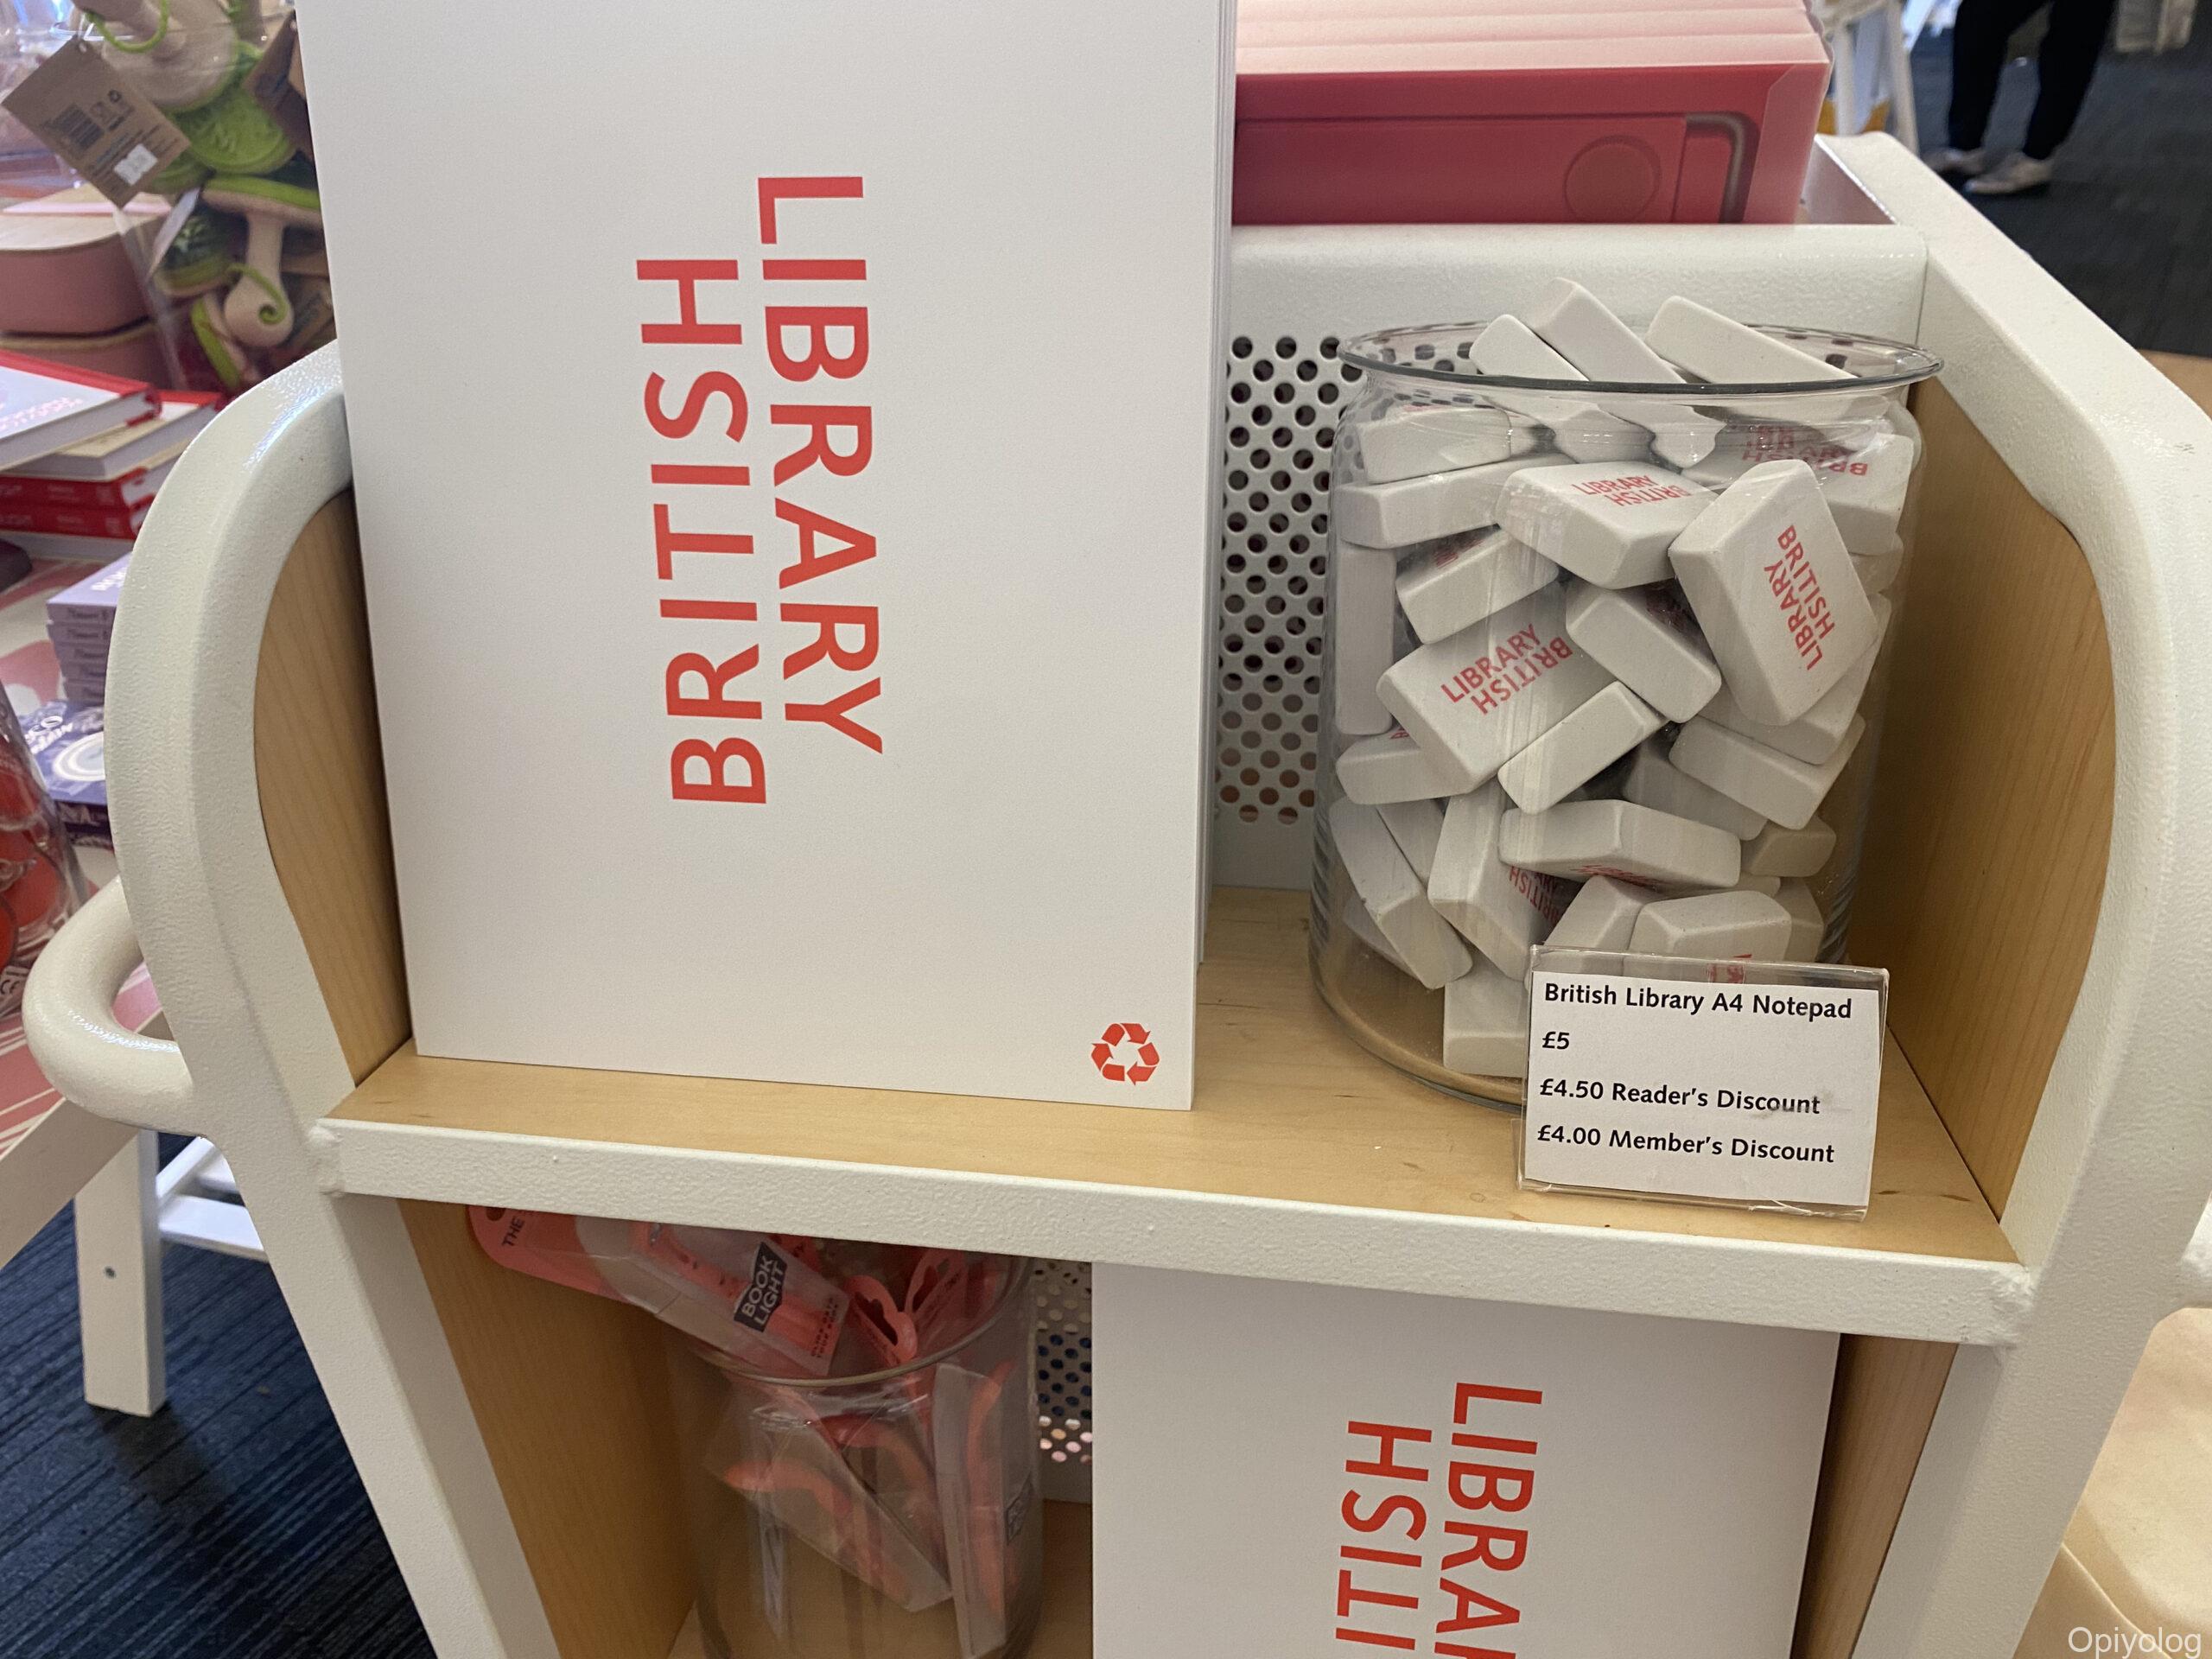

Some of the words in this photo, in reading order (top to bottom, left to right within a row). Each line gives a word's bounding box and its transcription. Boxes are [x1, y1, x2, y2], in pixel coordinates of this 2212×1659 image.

[758, 176, 883, 754] LIBRARY
[1571, 474, 1659, 495] LIBRARY
[1604, 485, 1692, 507] BRITISH
[636, 259, 767, 804] BRITISH
[1777, 524, 1835, 639] BRITISH
[1764, 559, 1823, 671] LIBRARY
[1440, 623, 1541, 703] LIBRARY
[1471, 637, 1573, 715] BRITISH
[1544, 982, 1618, 1005] British
[1625, 987, 1705, 1015] Library
[1711, 992, 1744, 1013] A4
[1752, 995, 1853, 1022] Notepad
[1541, 1031, 1570, 1050] £5
[1539, 1078, 1605, 1100] £4.50
[1611, 1083, 1709, 1107] Reader's
[1717, 1090, 1821, 1115] Discount
[1537, 1124, 1601, 1146] £4.00
[1608, 1129, 1723, 1155] Member's
[1731, 1138, 1835, 1163] Discount
[501, 1215, 525, 1247] THE
[741, 1255, 775, 1319] BOOK
[754, 1260, 784, 1325] LIGHT
[1335, 1420, 1433, 1651] ITISH
[1433, 1382, 1543, 1659] LIBRA
